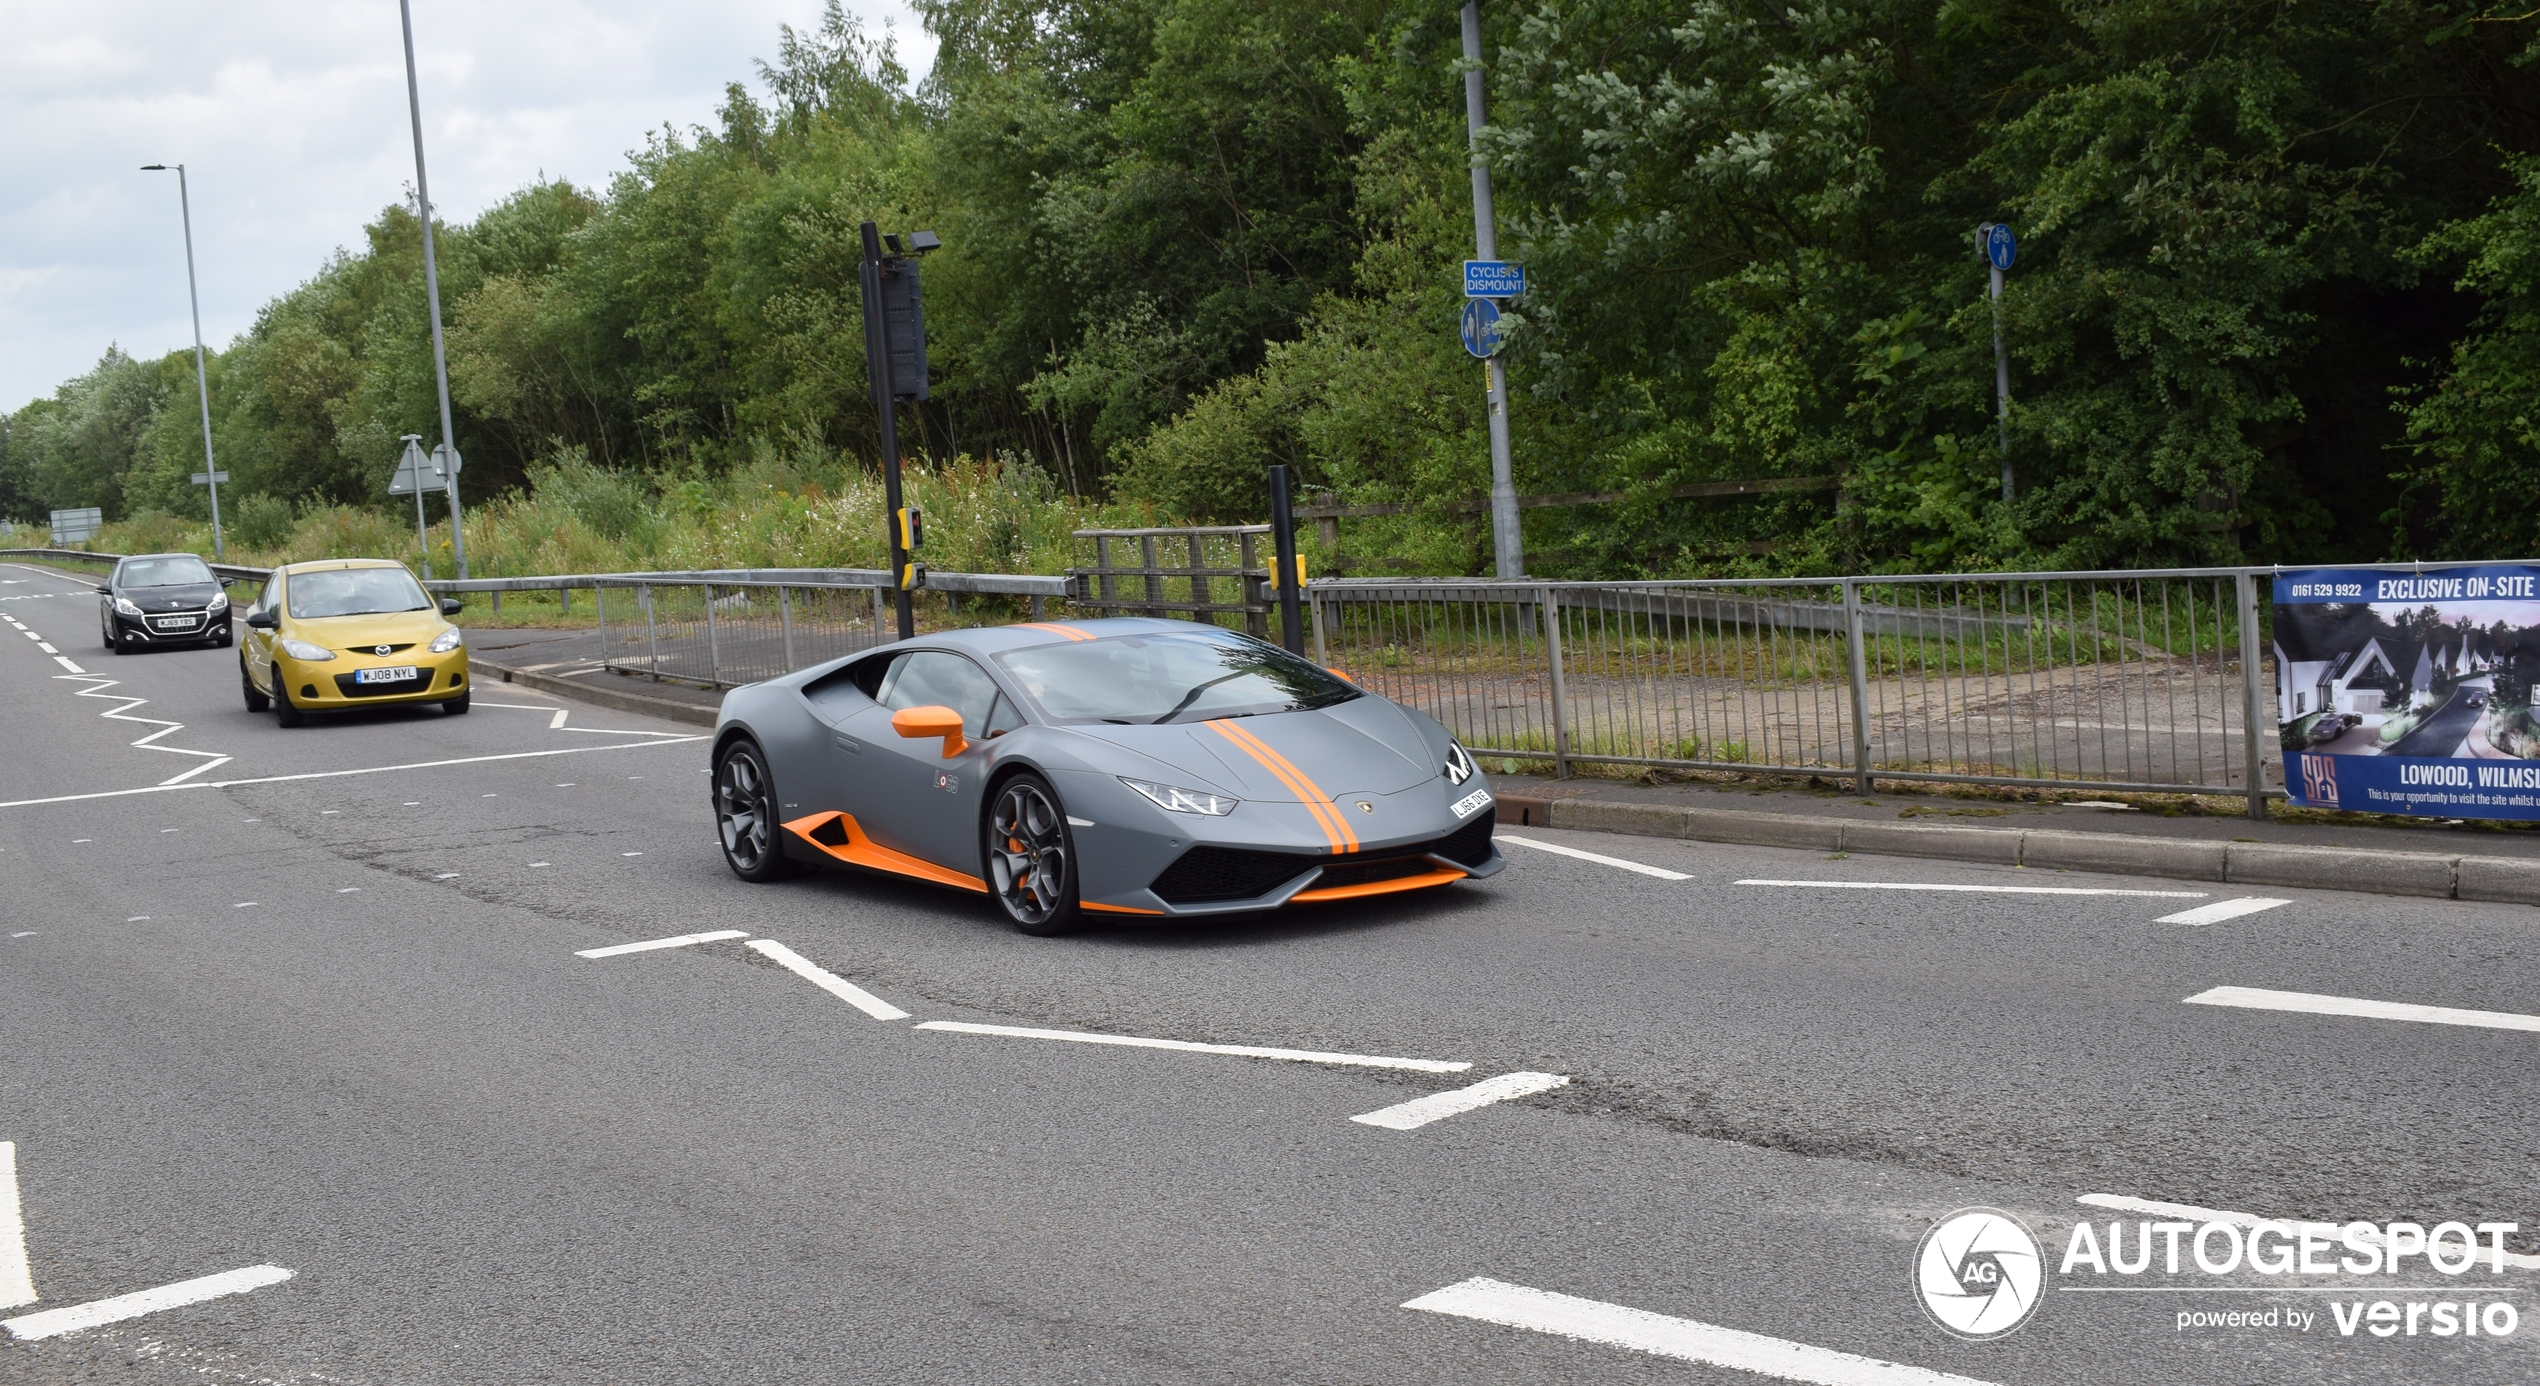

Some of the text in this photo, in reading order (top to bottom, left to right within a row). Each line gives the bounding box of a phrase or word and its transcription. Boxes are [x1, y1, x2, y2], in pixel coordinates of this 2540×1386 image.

[1467, 279, 1522, 291] DISMOUNT
[2292, 583, 2362, 597] 0161 529 9922
[2377, 576, 2535, 599] EXCLUSIVE ON-SITE
[363, 667, 415, 681] WJ08 NYL
[2300, 754, 2339, 801] SPS
[2400, 764, 2473, 789] LOWOOD,
[1452, 791, 1489, 816] LJ66 DXE
[2367, 787, 2382, 800] This
[2383, 789, 2390, 800] is
[2390, 790, 2405, 803] your
[2406, 791, 2448, 805] opportunity
[2449, 791, 2457, 804] to
[2458, 792, 2475, 805] visit
[2477, 792, 2490, 805] the
[2491, 793, 2507, 806] site
[2508, 793, 2534, 807] whilst
